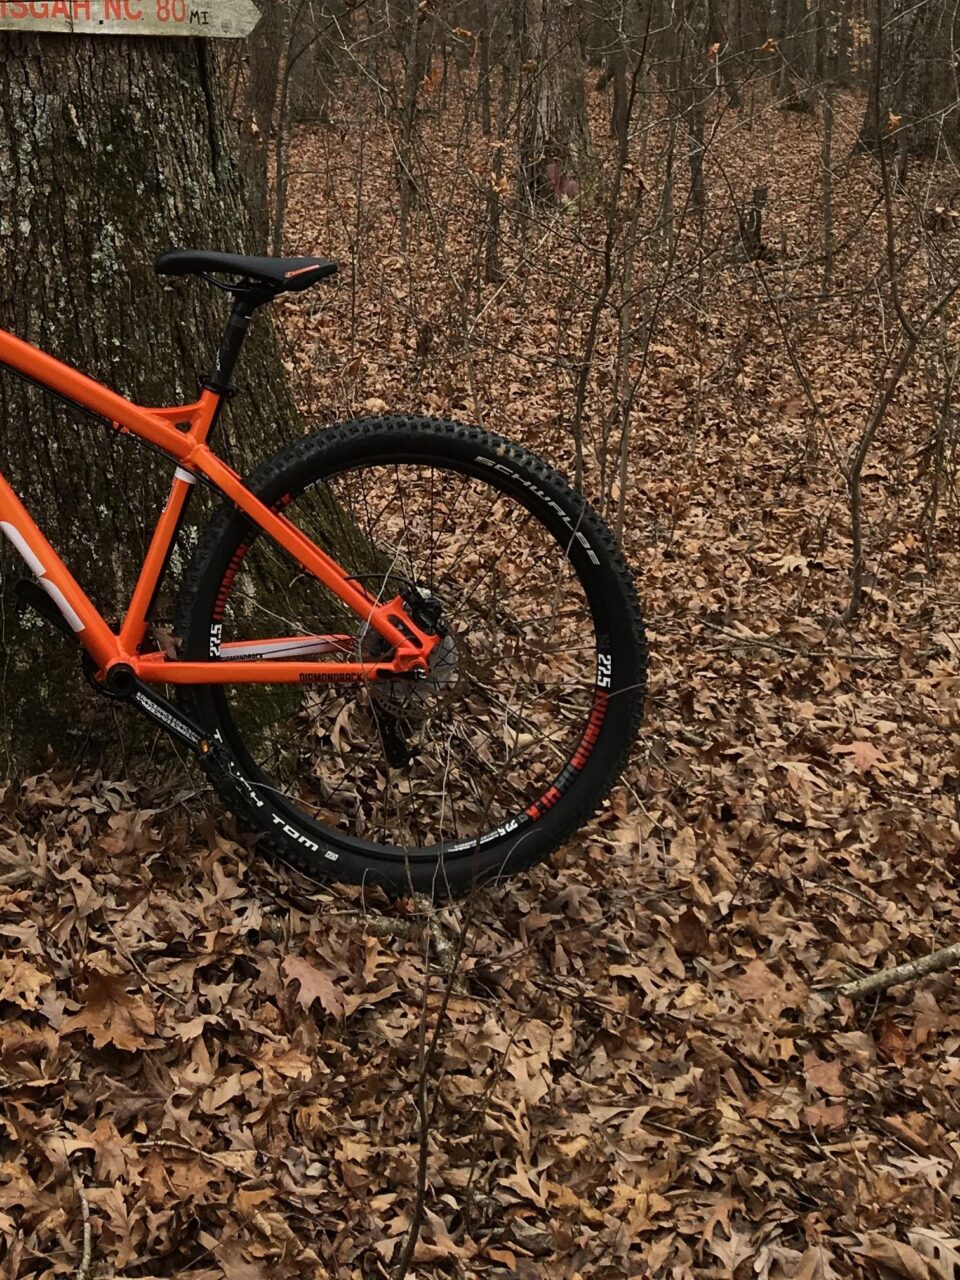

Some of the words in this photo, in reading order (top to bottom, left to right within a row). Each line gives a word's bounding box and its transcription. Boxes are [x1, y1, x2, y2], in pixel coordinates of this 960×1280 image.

[189, 10, 210, 26] MI
[474, 456, 601, 566] SCHWALBE
[271, 812, 320, 853] TOM
